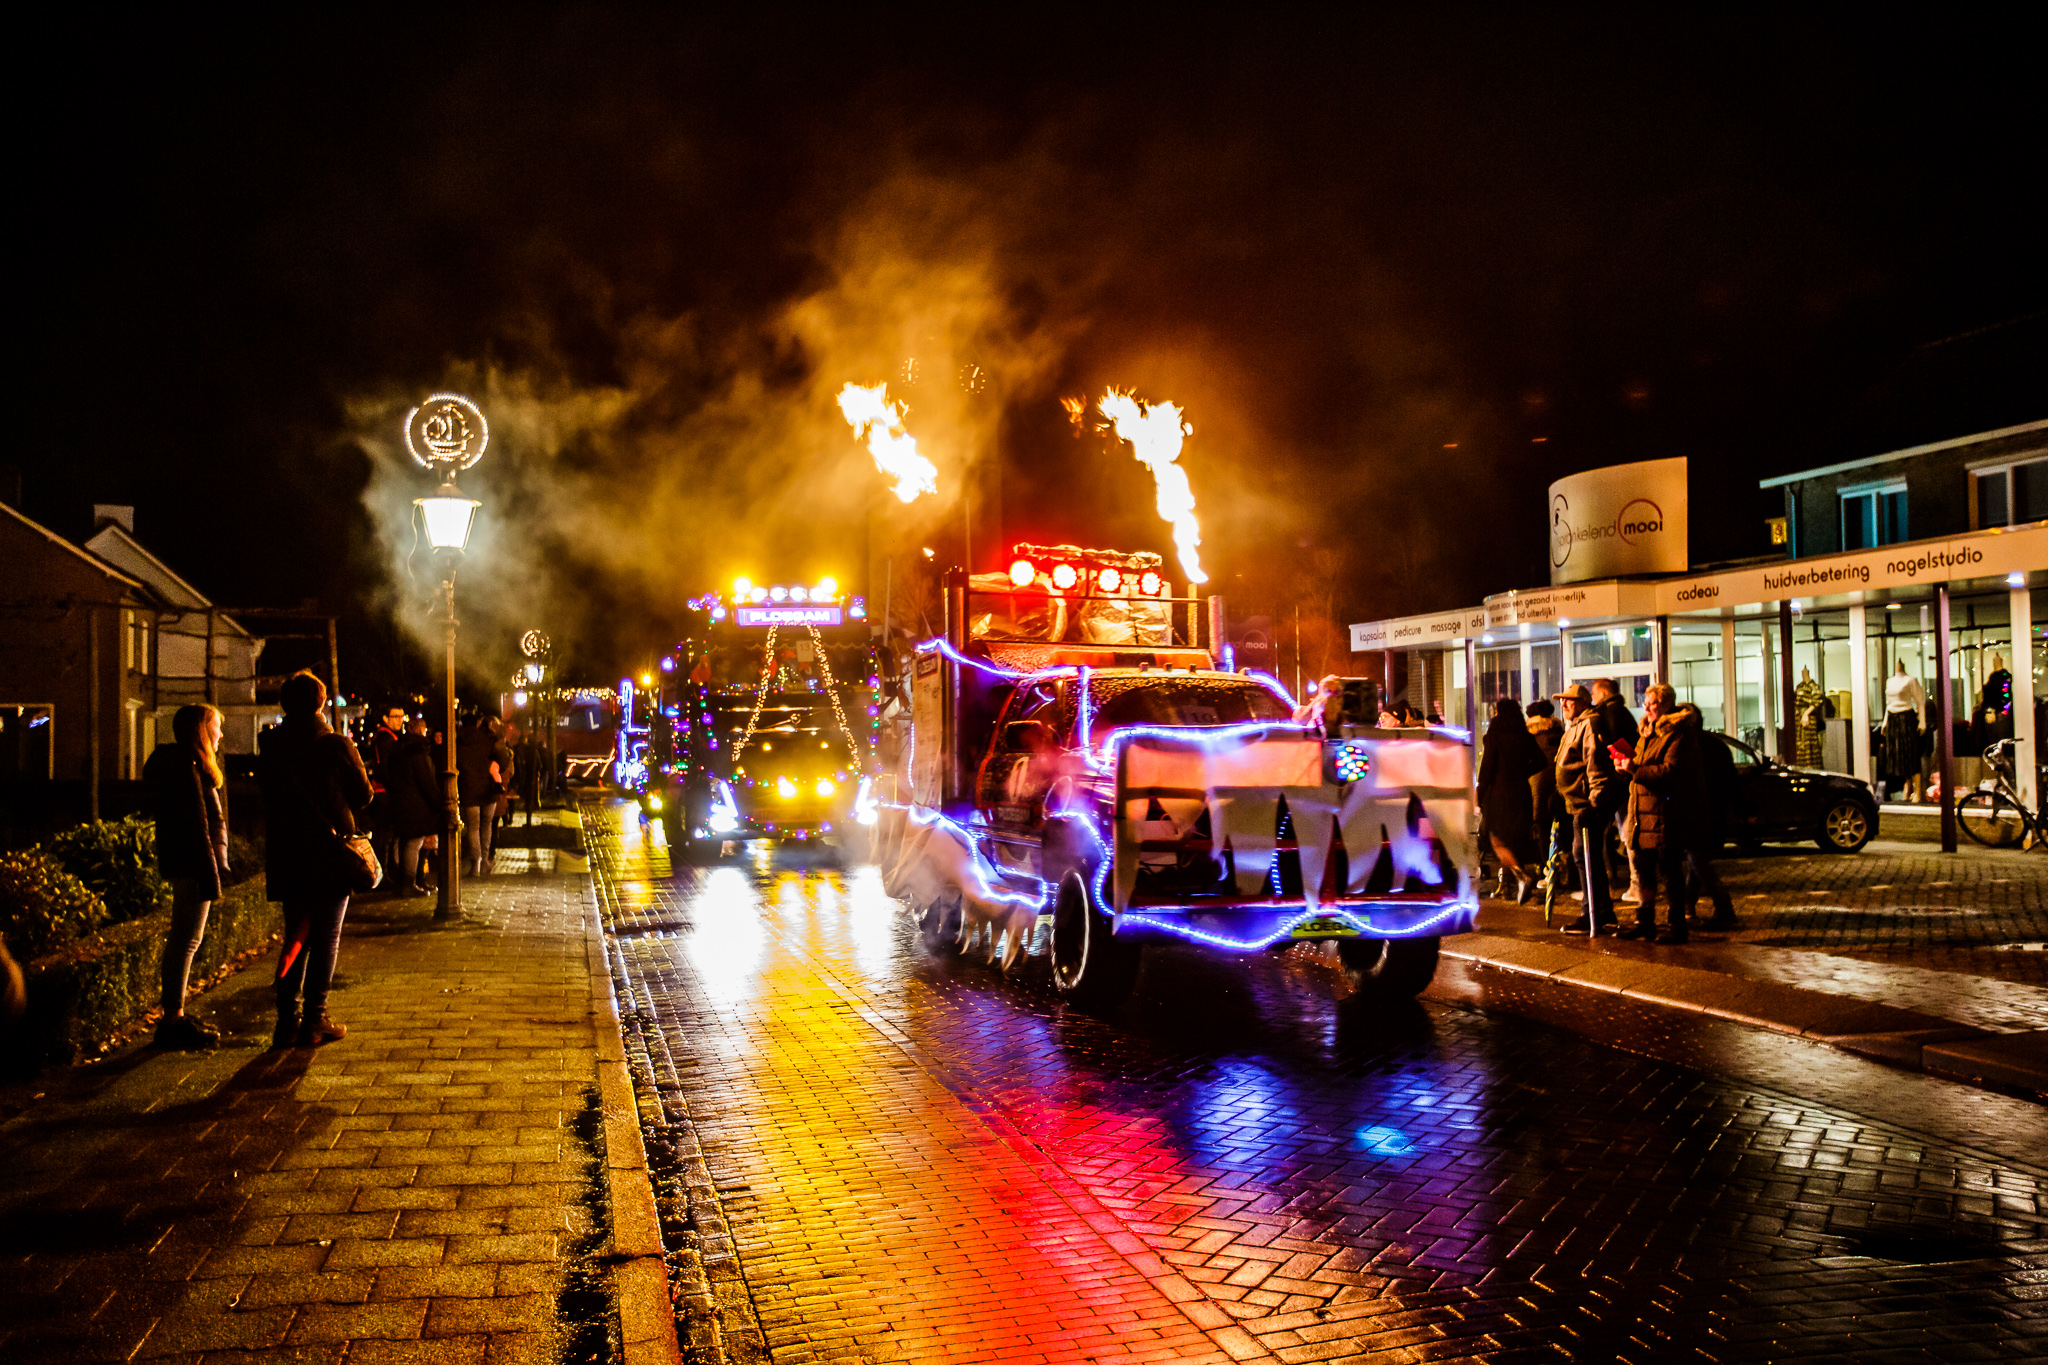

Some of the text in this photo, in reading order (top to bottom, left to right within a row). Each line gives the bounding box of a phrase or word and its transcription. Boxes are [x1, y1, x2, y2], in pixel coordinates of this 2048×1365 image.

[1624, 520, 1663, 535] mooi
[1886, 547, 1983, 577] nagelstudio
[1763, 564, 1871, 590] huidverbetering
[1525, 594, 1551, 608] gezond
[1552, 590, 1586, 603] innerlijk
[1676, 585, 1720, 602] cadeau
[1526, 606, 1556, 619] uiterlijk!
[1359, 613, 1485, 645] kapsalon pedicure massage afsl
[1245, 641, 1268, 650] mooi
